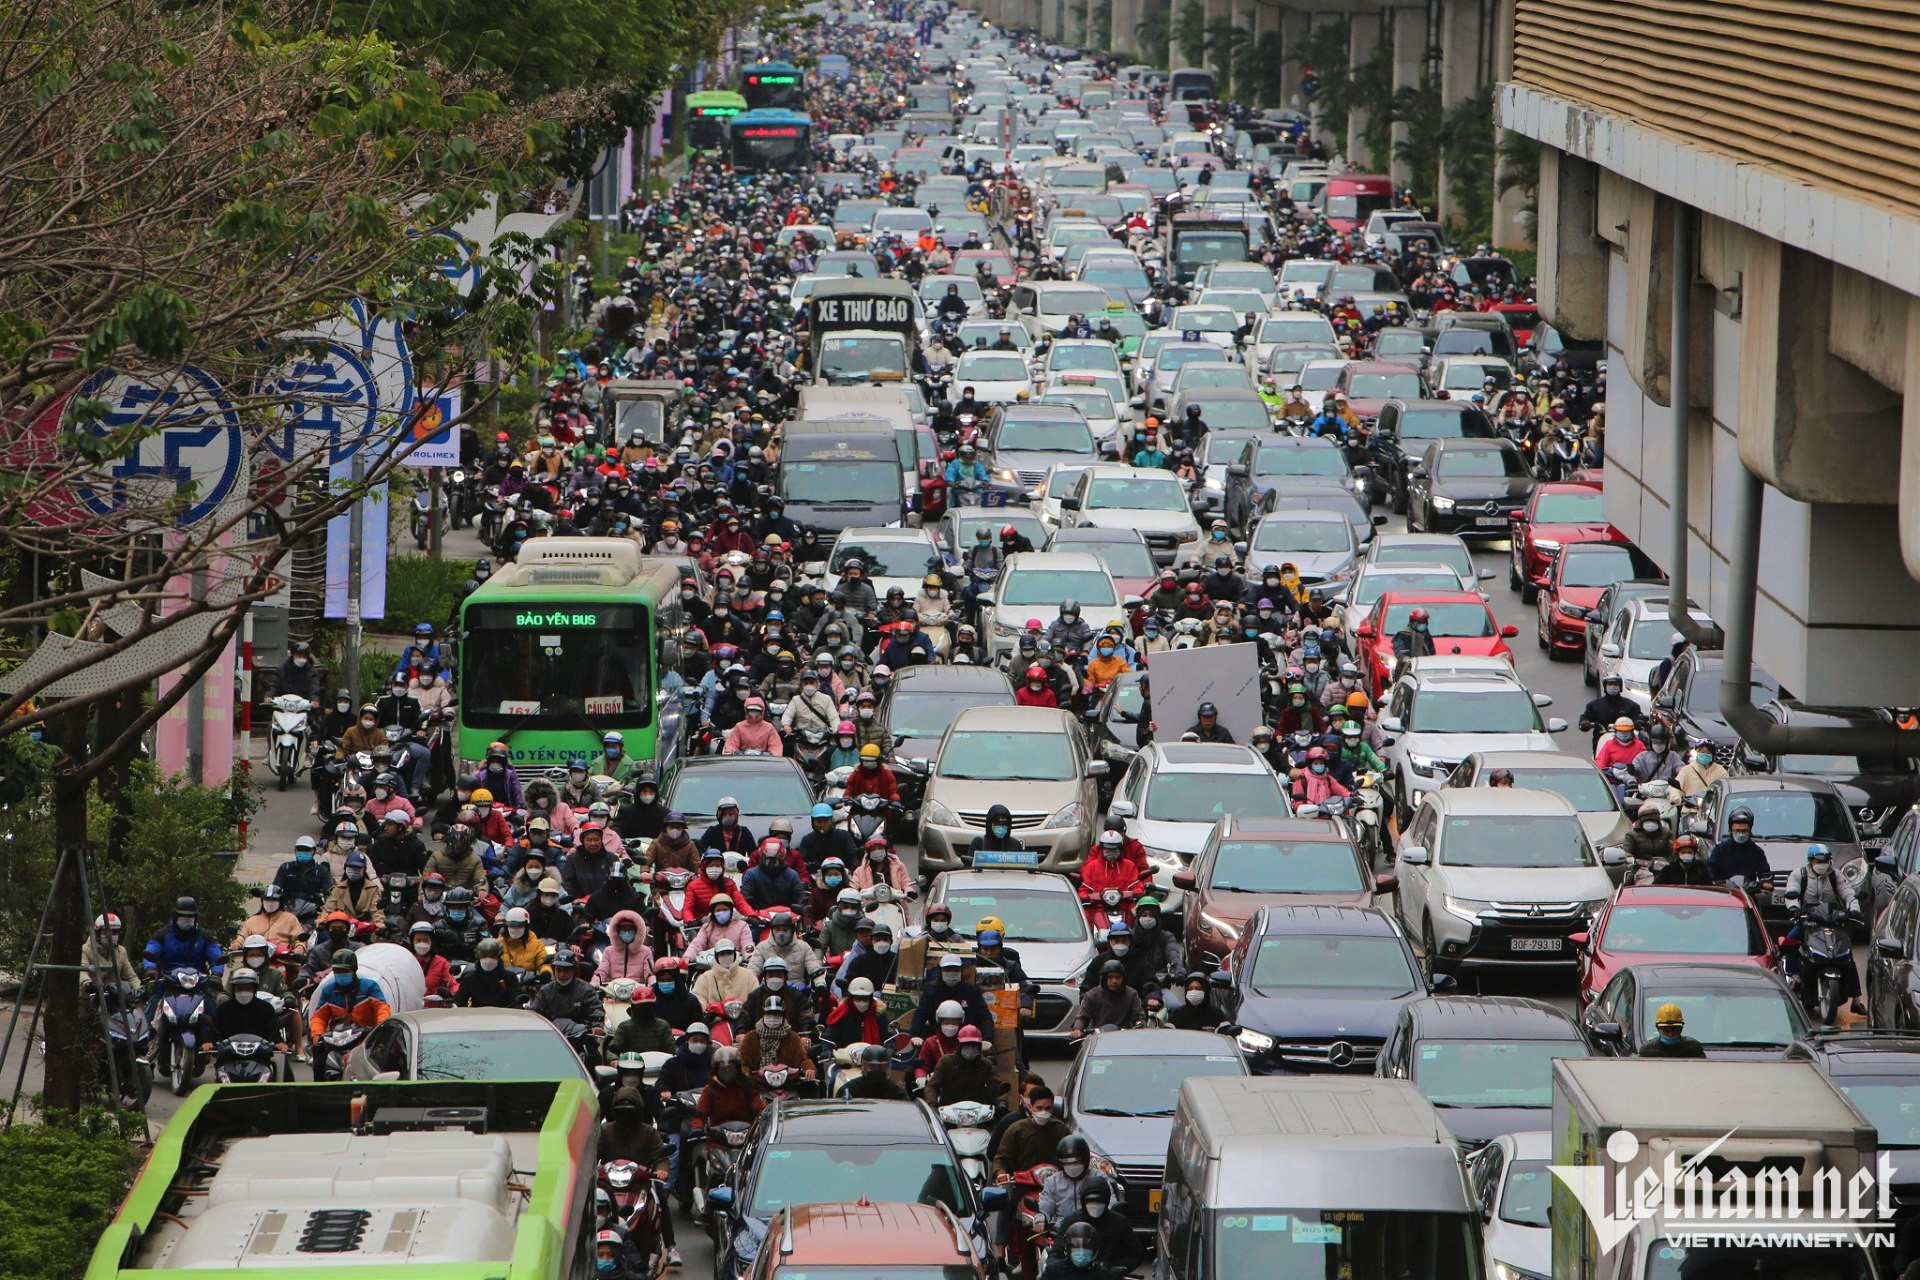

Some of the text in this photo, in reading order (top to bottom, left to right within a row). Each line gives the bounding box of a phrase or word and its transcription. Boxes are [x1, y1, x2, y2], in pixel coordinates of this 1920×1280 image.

[818, 296, 908, 322] XE THƯ BÁO
[572, 614, 597, 626] BUS
[528, 745, 556, 760] YẾN
[559, 749, 587, 760] CNG
[1512, 940, 1561, 950] 30F-793.19
